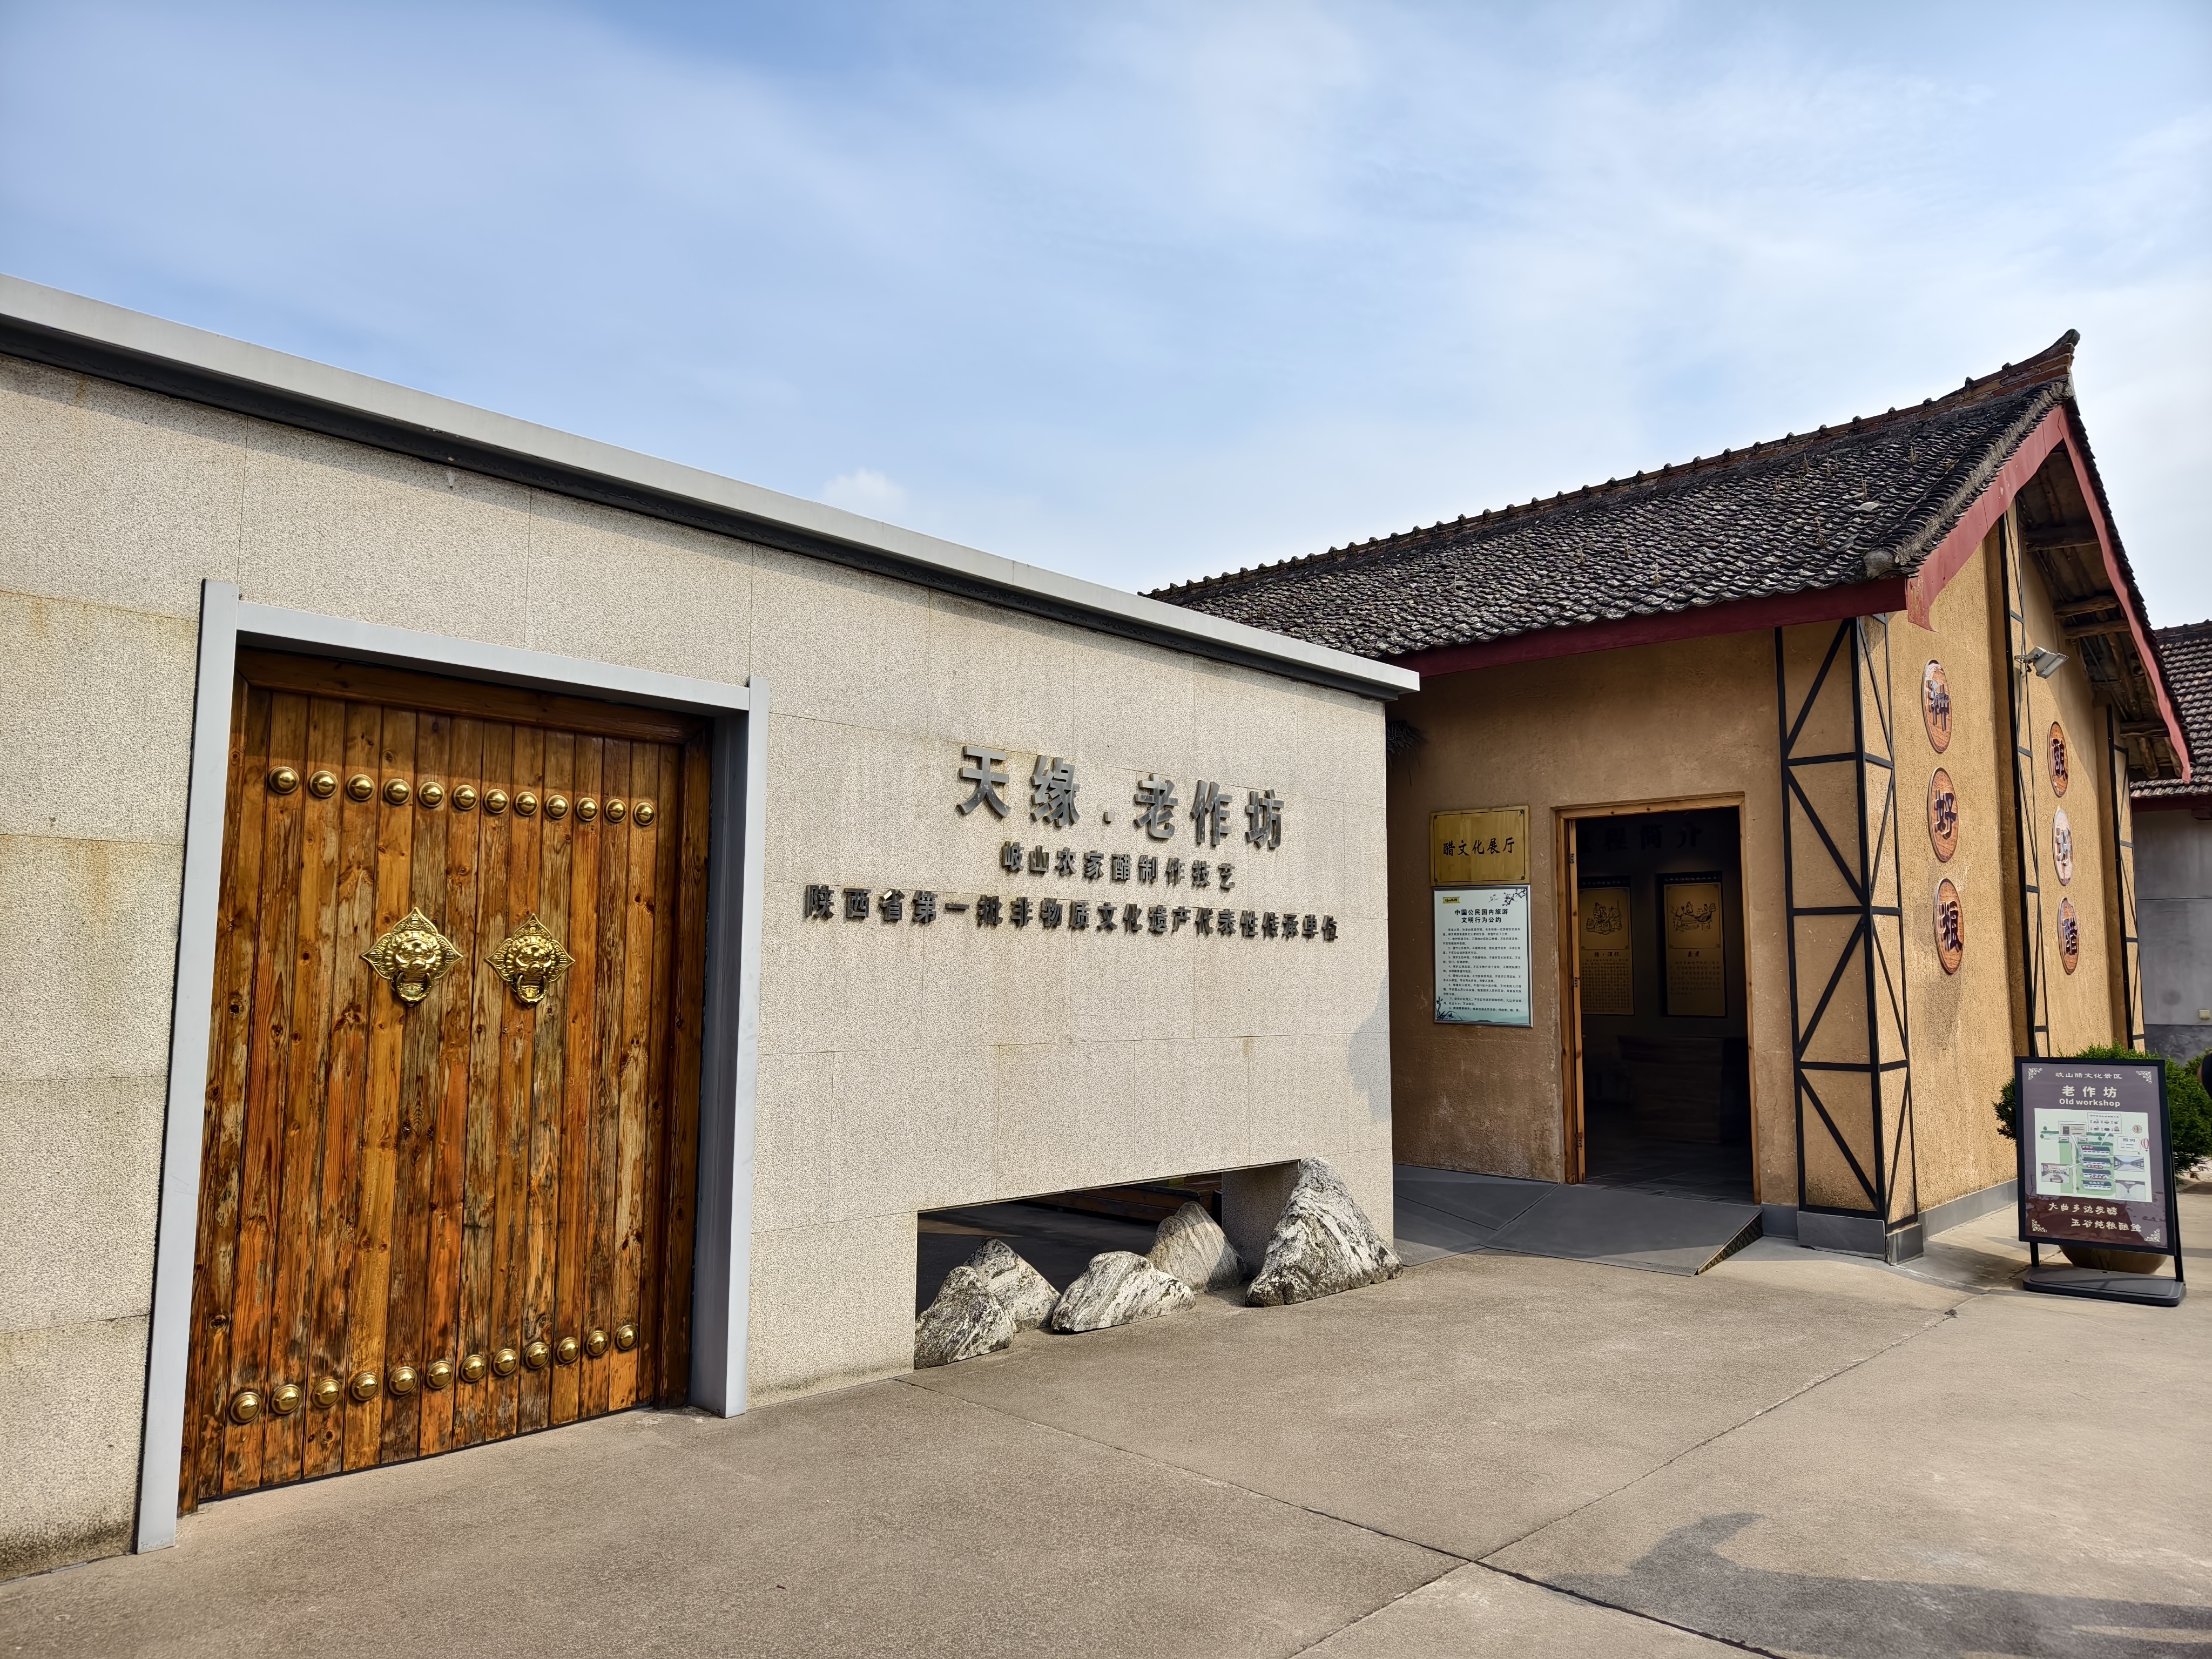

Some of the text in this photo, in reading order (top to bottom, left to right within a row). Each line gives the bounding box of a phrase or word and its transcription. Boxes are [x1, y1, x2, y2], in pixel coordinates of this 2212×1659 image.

[1442, 837, 1515, 857] 醋文化展厅
[1001, 840, 1236, 893] 岐山农家醋制作技艺
[805, 884, 1339, 942] 陕西省第一批非物质文化遗产代表性传承单位
[2055, 1071, 2122, 1080] 岐山醋文化景区
[2062, 1085, 2117, 1098] 老作坊
[2076, 1099, 2121, 1108] workshop
[2048, 1202, 2118, 1216] 大曲多边发酵
[2071, 1218, 2142, 1232] 五谷纯粮酿造
